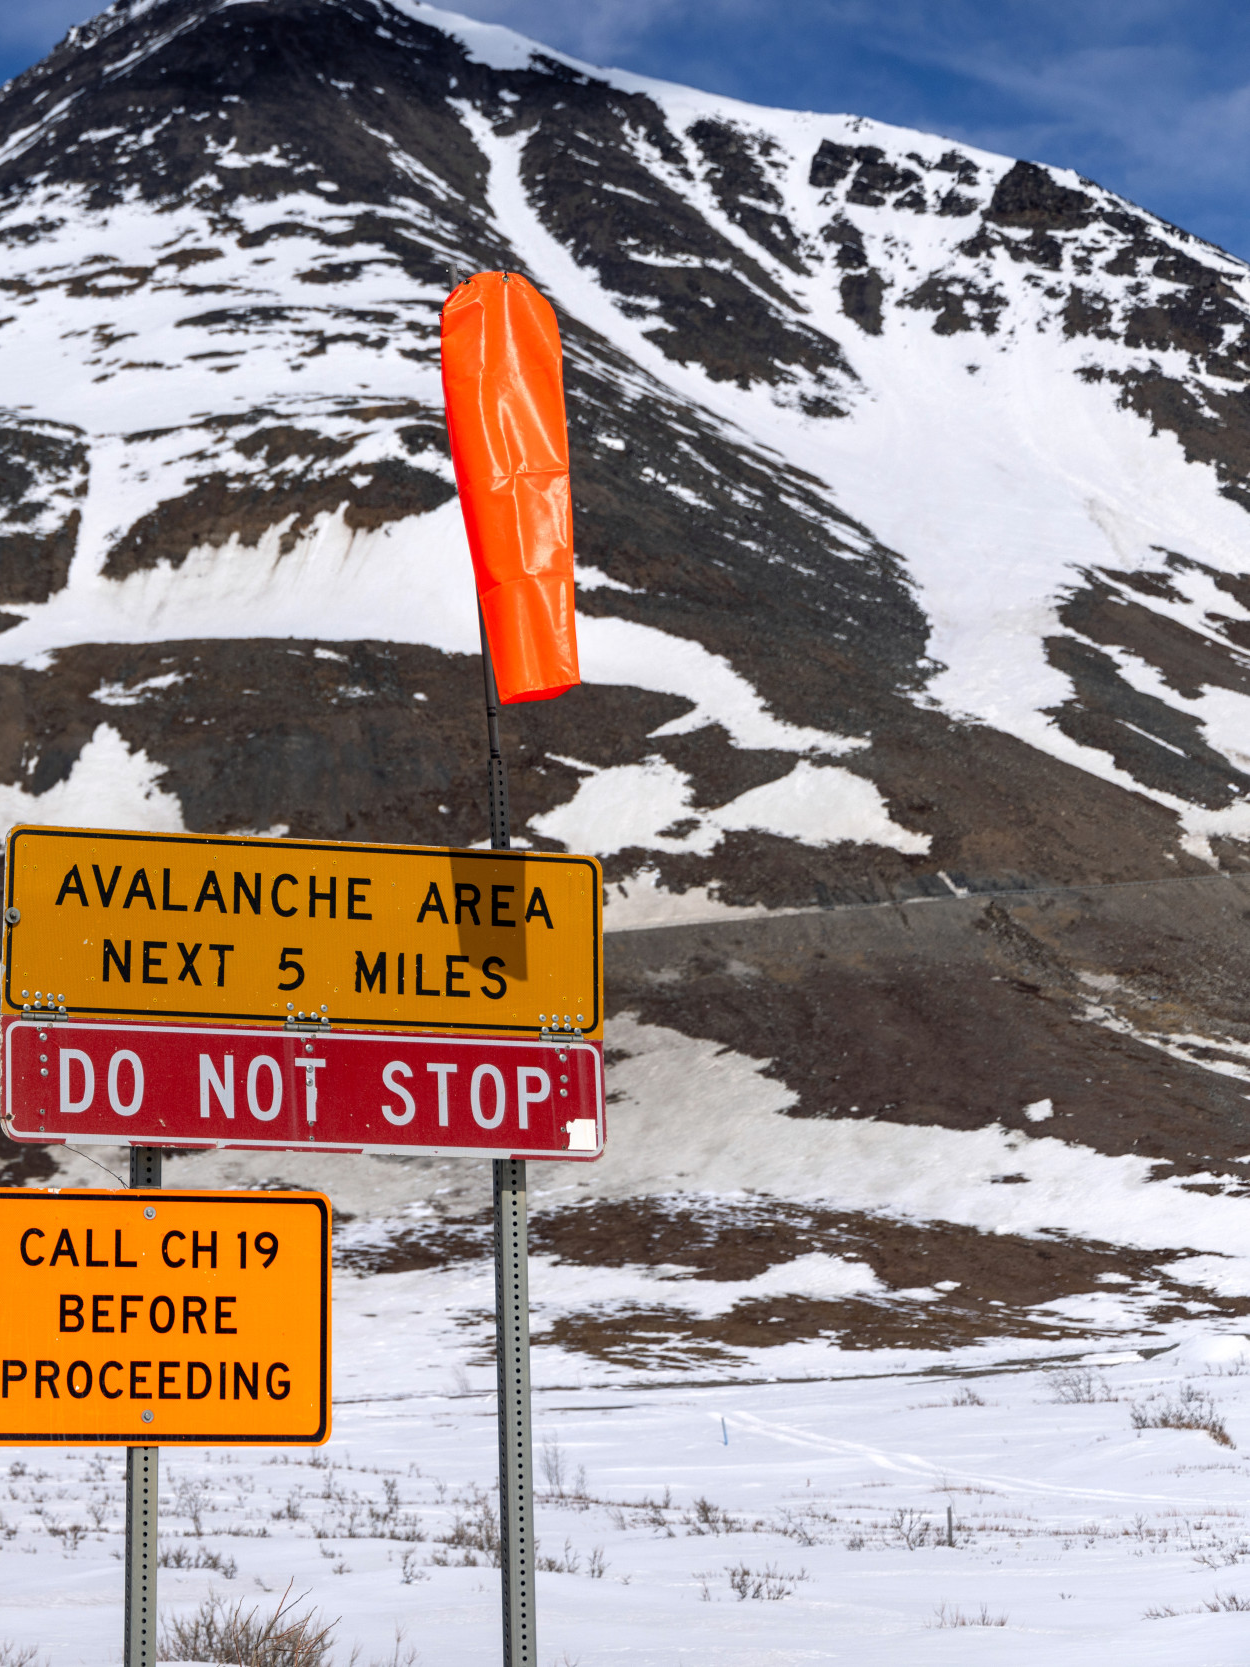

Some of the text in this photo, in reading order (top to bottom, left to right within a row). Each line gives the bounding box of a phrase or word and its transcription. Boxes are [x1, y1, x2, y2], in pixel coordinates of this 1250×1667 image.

[55, 863, 554, 929] AVALANCHE AREA
[102, 938, 507, 999] NEXT 5 MILES
[59, 1048, 551, 1129] DO NOT STOP
[20, 1228, 279, 1269] CALL CH 19
[58, 1294, 238, 1334] BEFORE
[1, 1359, 291, 1400] PROCEEDING
